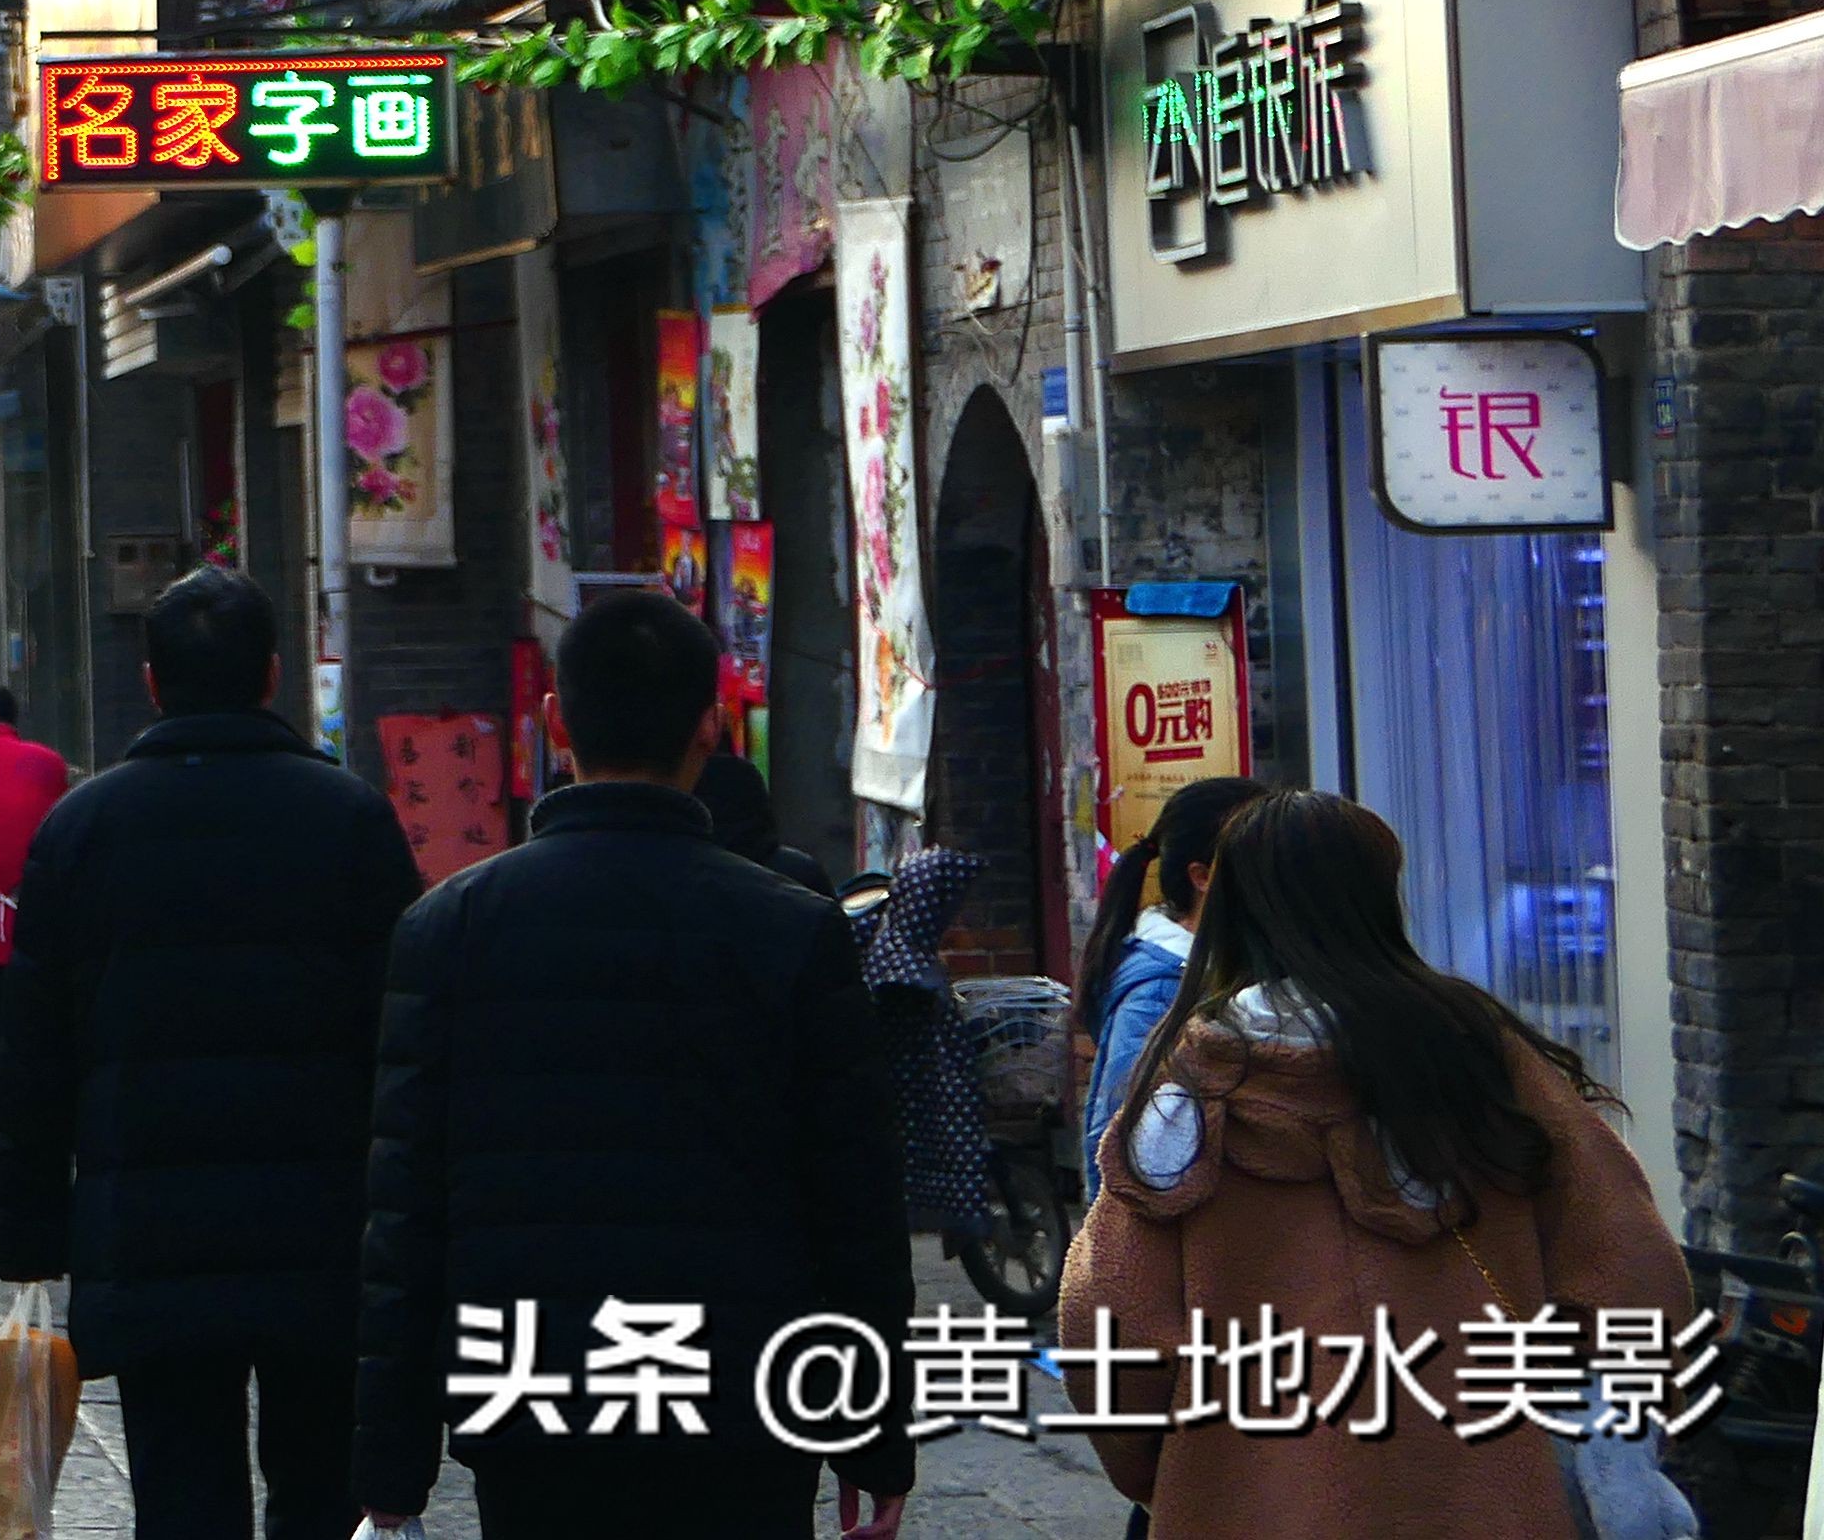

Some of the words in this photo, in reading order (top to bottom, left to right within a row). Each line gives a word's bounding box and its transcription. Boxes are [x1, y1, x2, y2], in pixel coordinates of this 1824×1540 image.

[58, 72, 433, 168] 名家字画
[1437, 384, 1544, 481] 银
